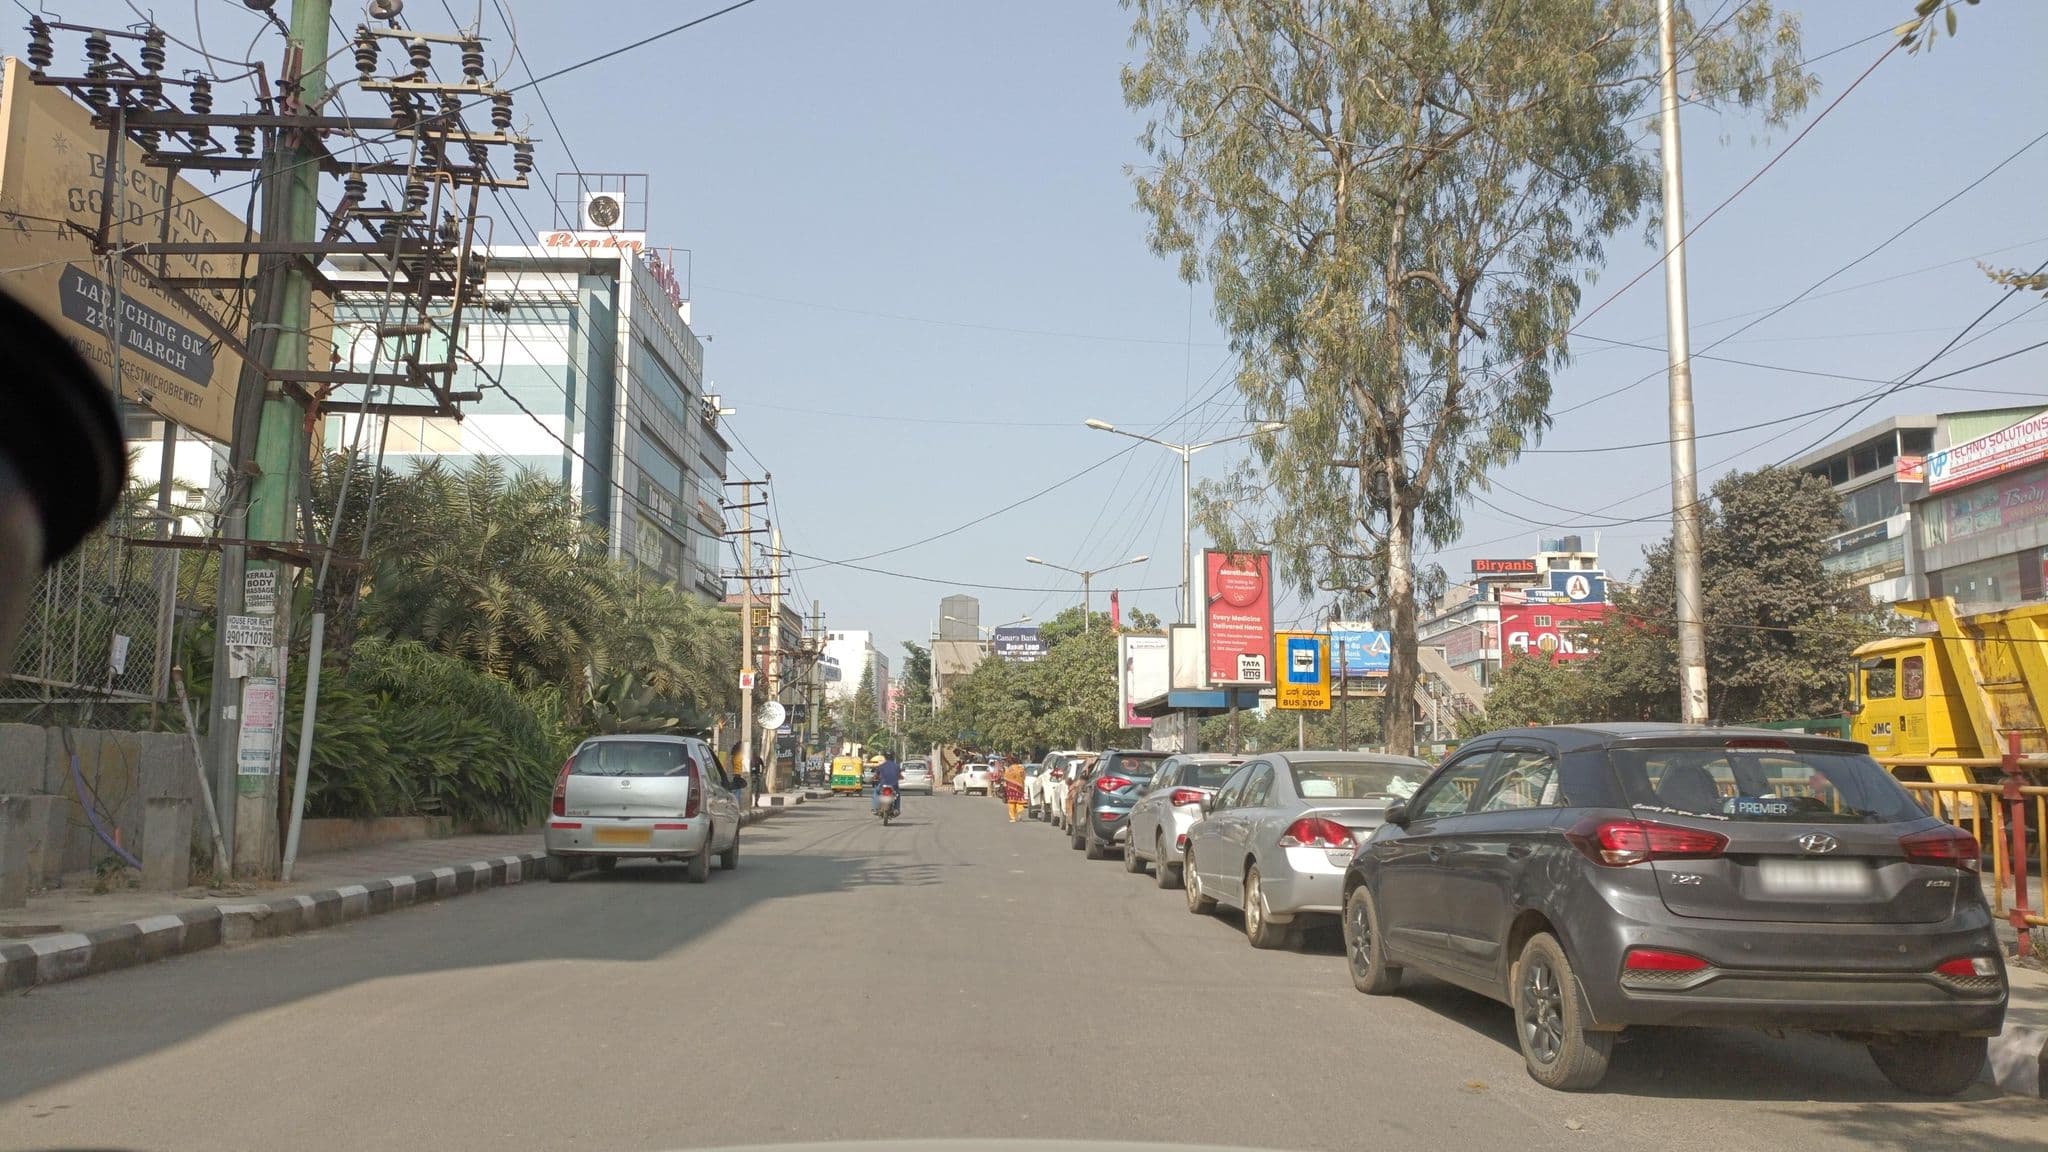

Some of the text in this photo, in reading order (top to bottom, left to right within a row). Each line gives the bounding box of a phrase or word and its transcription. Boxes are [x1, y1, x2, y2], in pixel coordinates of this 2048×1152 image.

[128, 329, 187, 371] MARCH
[181, 334, 203, 356] ON
[1950, 416, 2048, 460] TECHNO SOLUTIONS
[1476, 560, 1534, 573] Biryanis
[247, 580, 272, 588] BODY
[1213, 614, 1230, 622] Every
[227, 630, 272, 646] 9901710789
[996, 633, 1020, 641] Canara
[1242, 669, 1260, 679] 1mg
[1871, 722, 1891, 735] JMC
[1739, 802, 1788, 815] PREMIER
